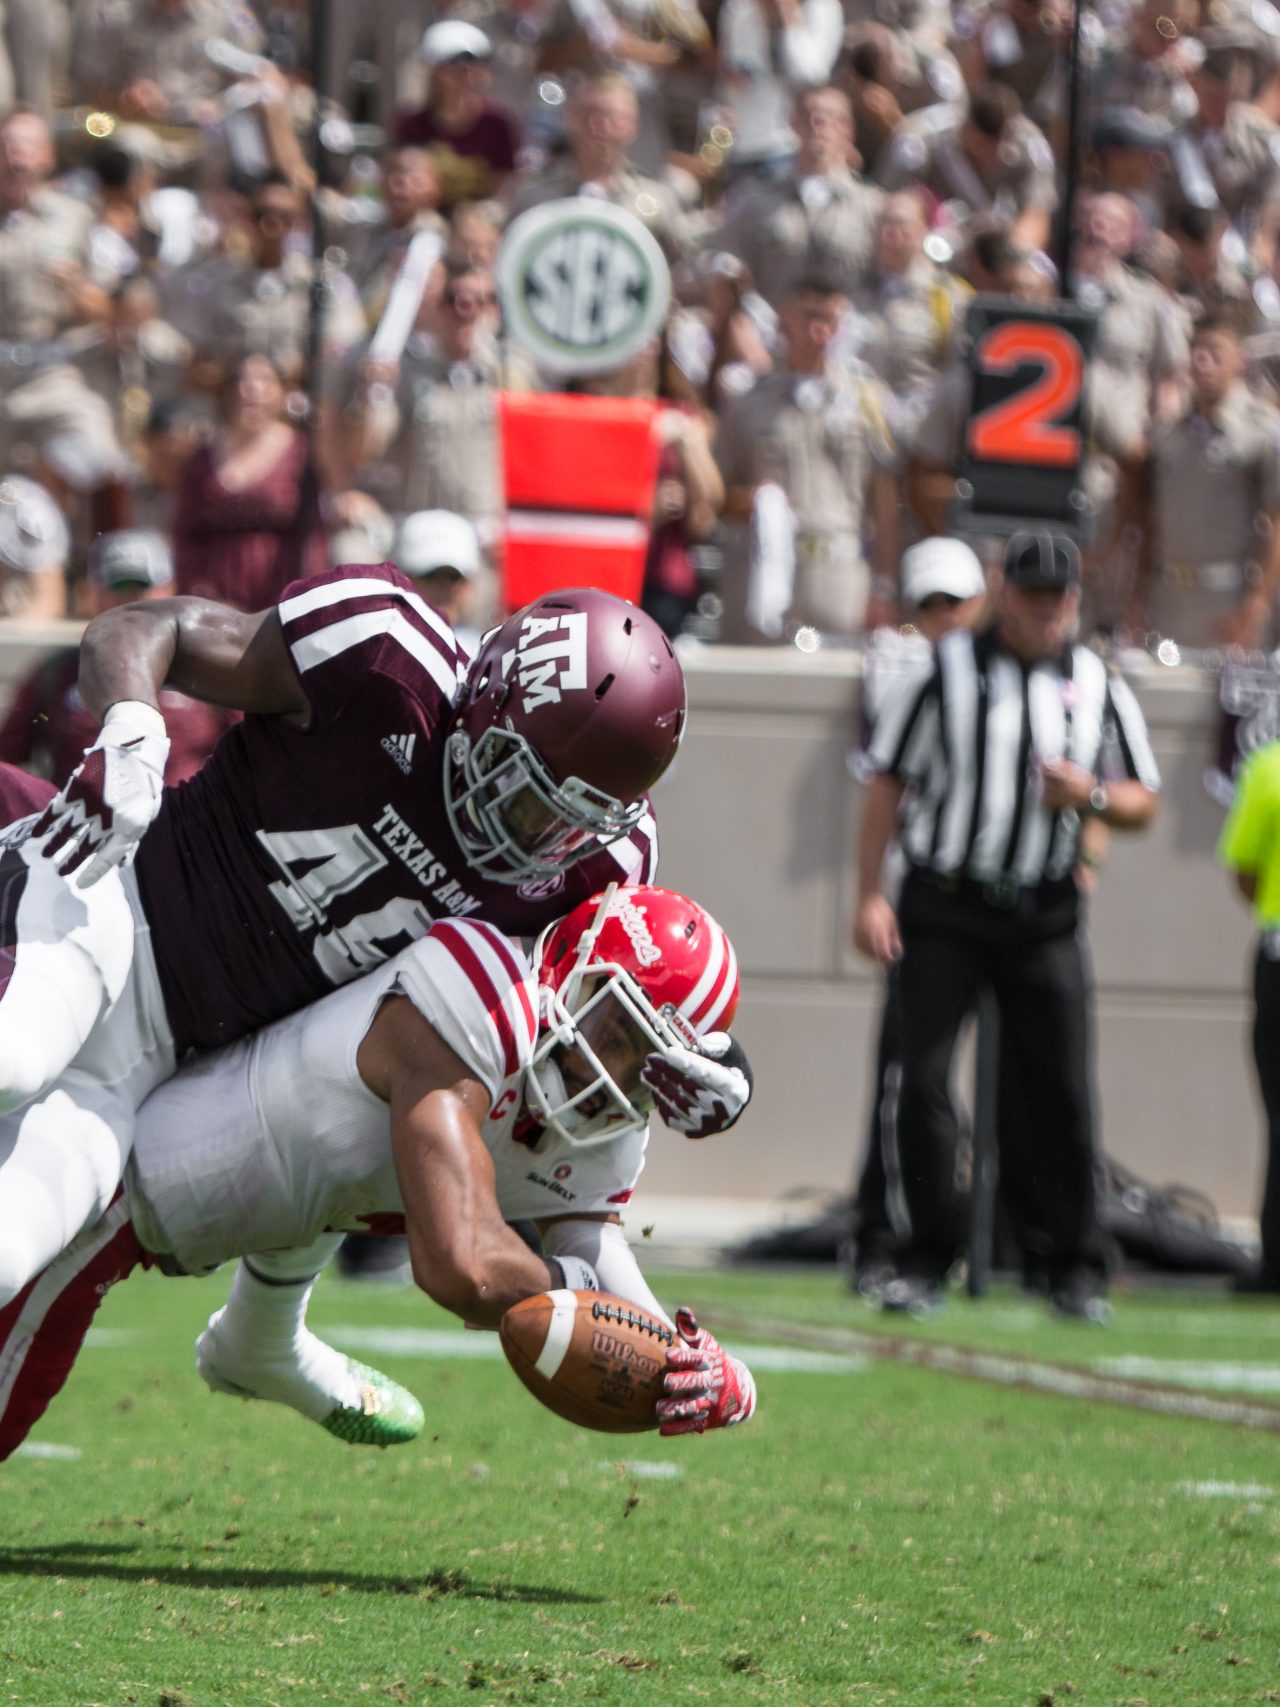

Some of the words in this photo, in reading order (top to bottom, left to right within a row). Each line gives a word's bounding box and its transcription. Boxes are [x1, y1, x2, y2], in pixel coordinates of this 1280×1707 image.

[526, 229, 646, 342] SEC
[970, 320, 1086, 468] 2
[380, 738, 413, 775] adidas
[373, 803, 448, 887] TEXAS
[431, 878, 483, 917] A&M
[489, 1088, 517, 1121] C
[592, 1332, 661, 1375] Wilson
